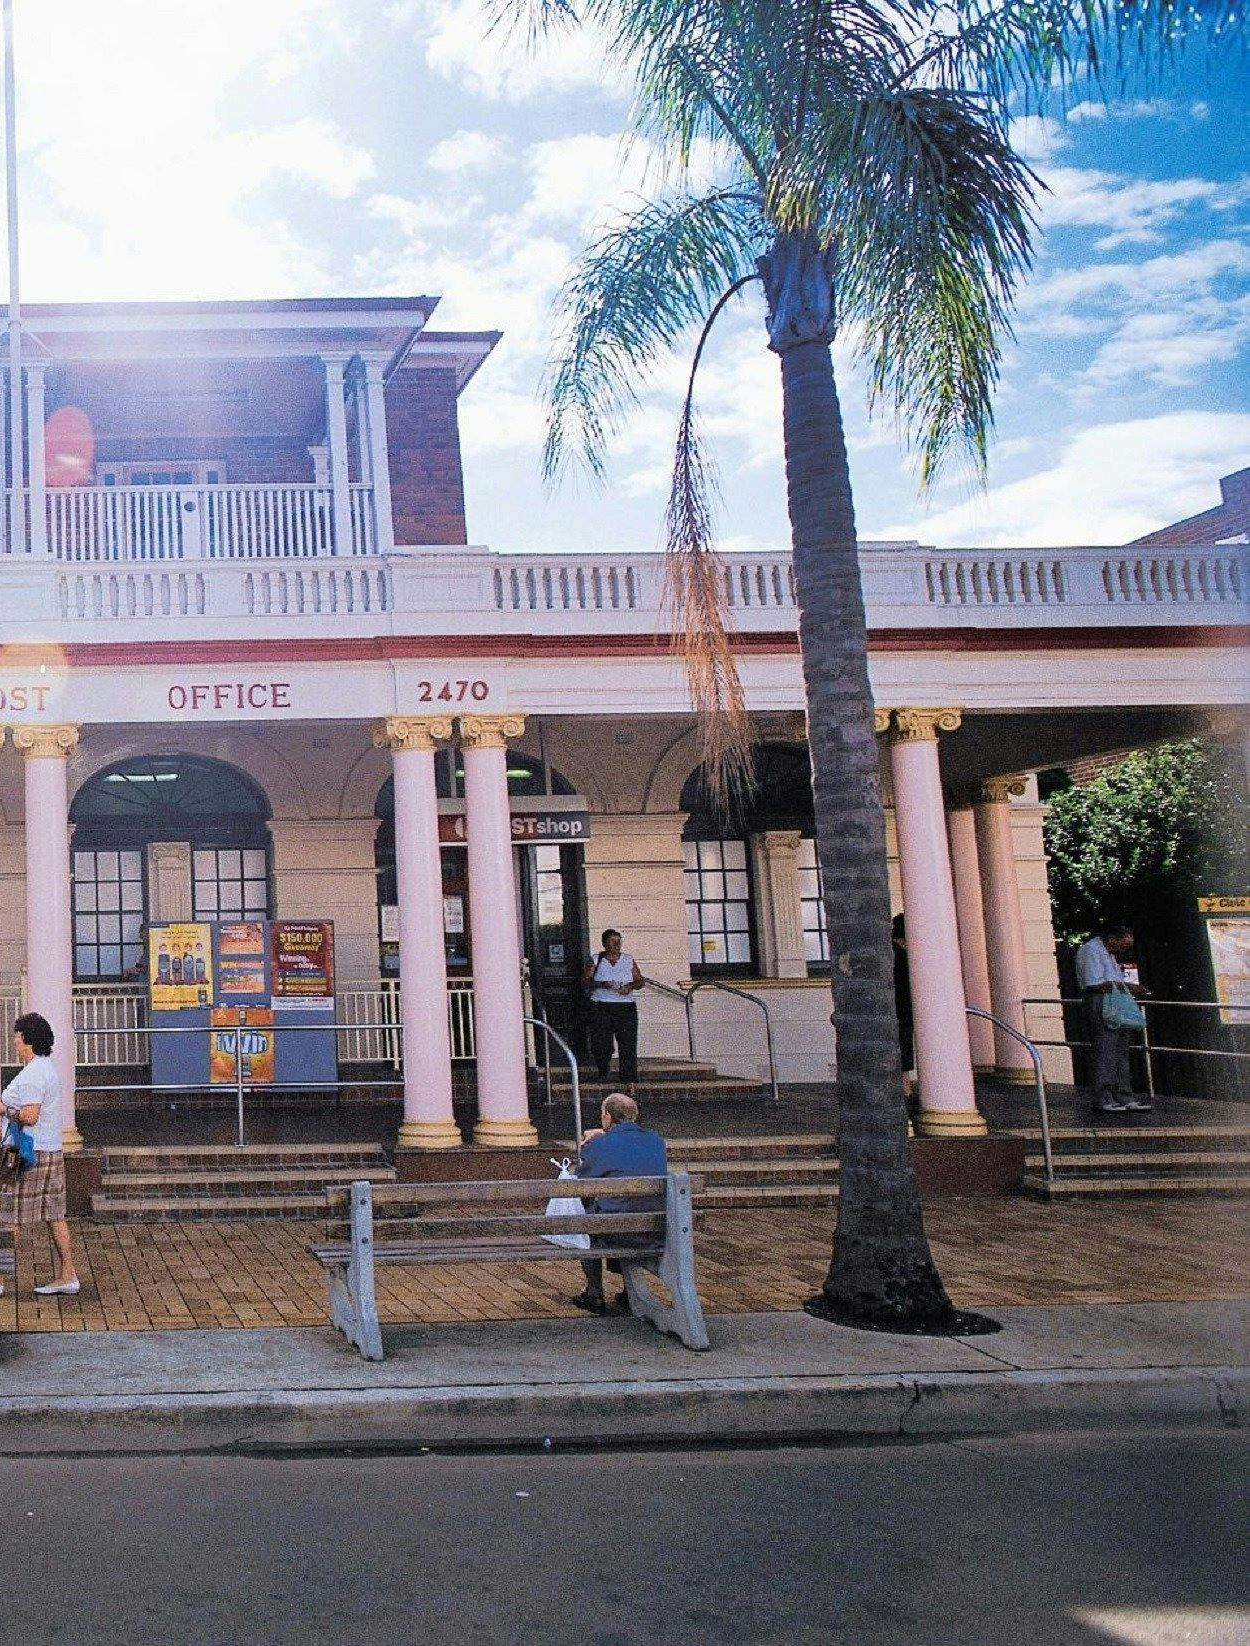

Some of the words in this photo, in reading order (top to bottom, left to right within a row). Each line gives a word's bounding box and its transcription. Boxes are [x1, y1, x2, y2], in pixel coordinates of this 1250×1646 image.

[168, 684, 291, 709] OFFICE
[417, 680, 489, 702] 2470
[511, 817, 582, 836] STshop
